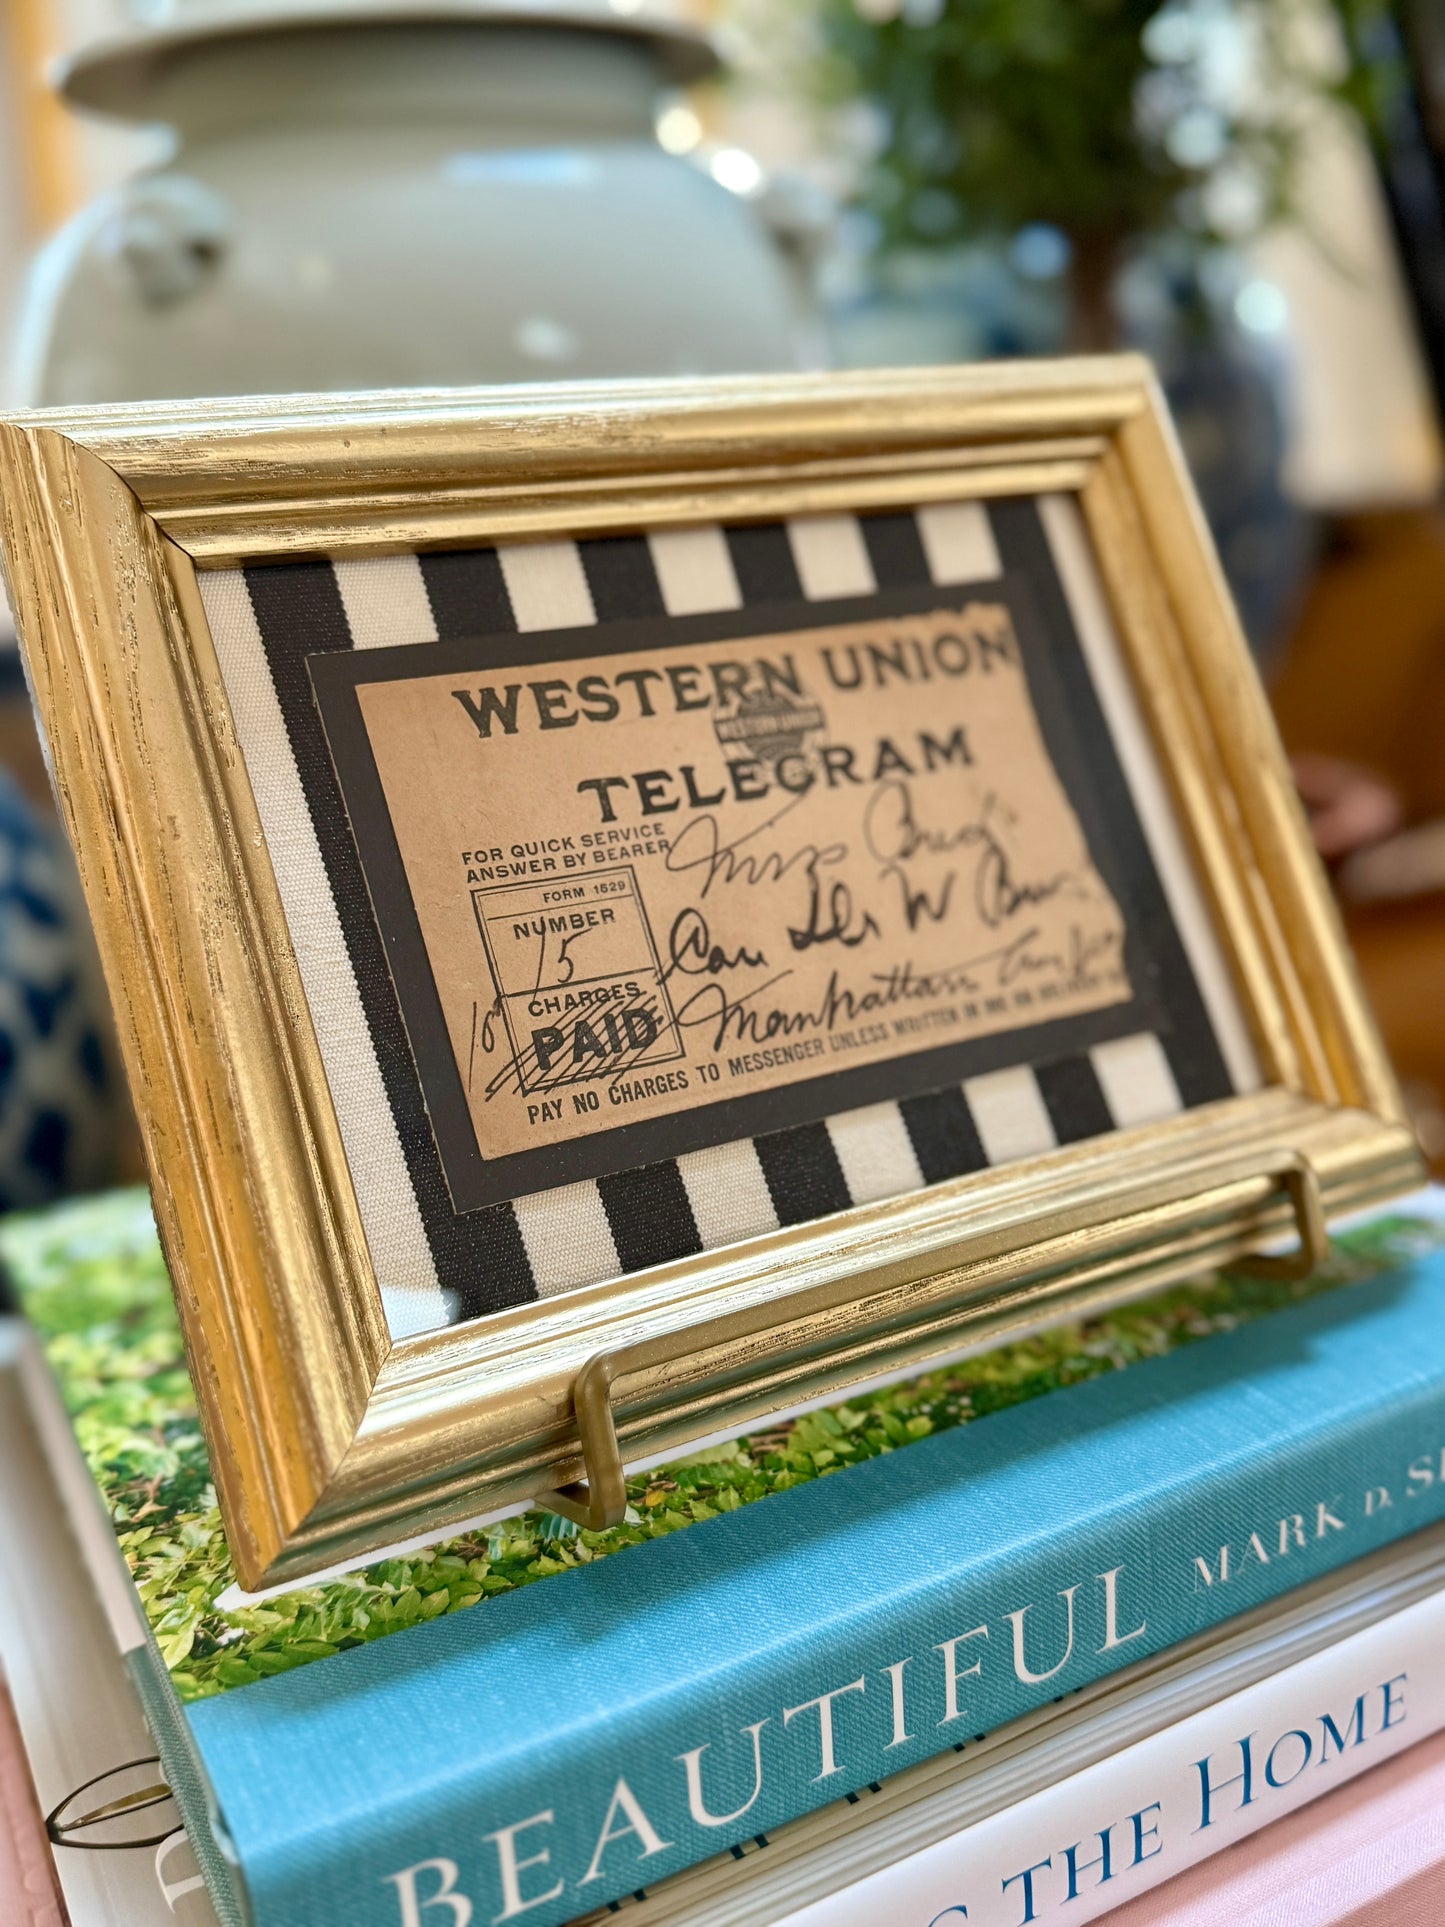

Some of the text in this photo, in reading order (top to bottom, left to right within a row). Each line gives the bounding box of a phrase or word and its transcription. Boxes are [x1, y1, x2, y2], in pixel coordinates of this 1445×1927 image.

[451, 628, 1014, 738] WESTERN UNION
[577, 727, 974, 823] TELEGRAM
[461, 822, 665, 865] FOR QUICK SERVICE
[466, 839, 670, 883] ANSWER BY BEARER
[543, 881, 626, 903] FORM 1529
[513, 908, 616, 940] NUMBER
[528, 981, 641, 1017] CHARGES
[531, 1008, 659, 1070] PAID
[527, 1098, 562, 1125] PAY
[573, 1091, 600, 1115] NO
[608, 1070, 689, 1106] CHARGES
[696, 1064, 720, 1084] TO
[728, 1038, 825, 1077] MESSENGER
[829, 1023, 888, 1051] UNLESS
[381, 1565, 1146, 1927] BEAUTIFUL
[1193, 1493, 1345, 1593] MARK
[1001, 1802, 1163, 1926] THE
